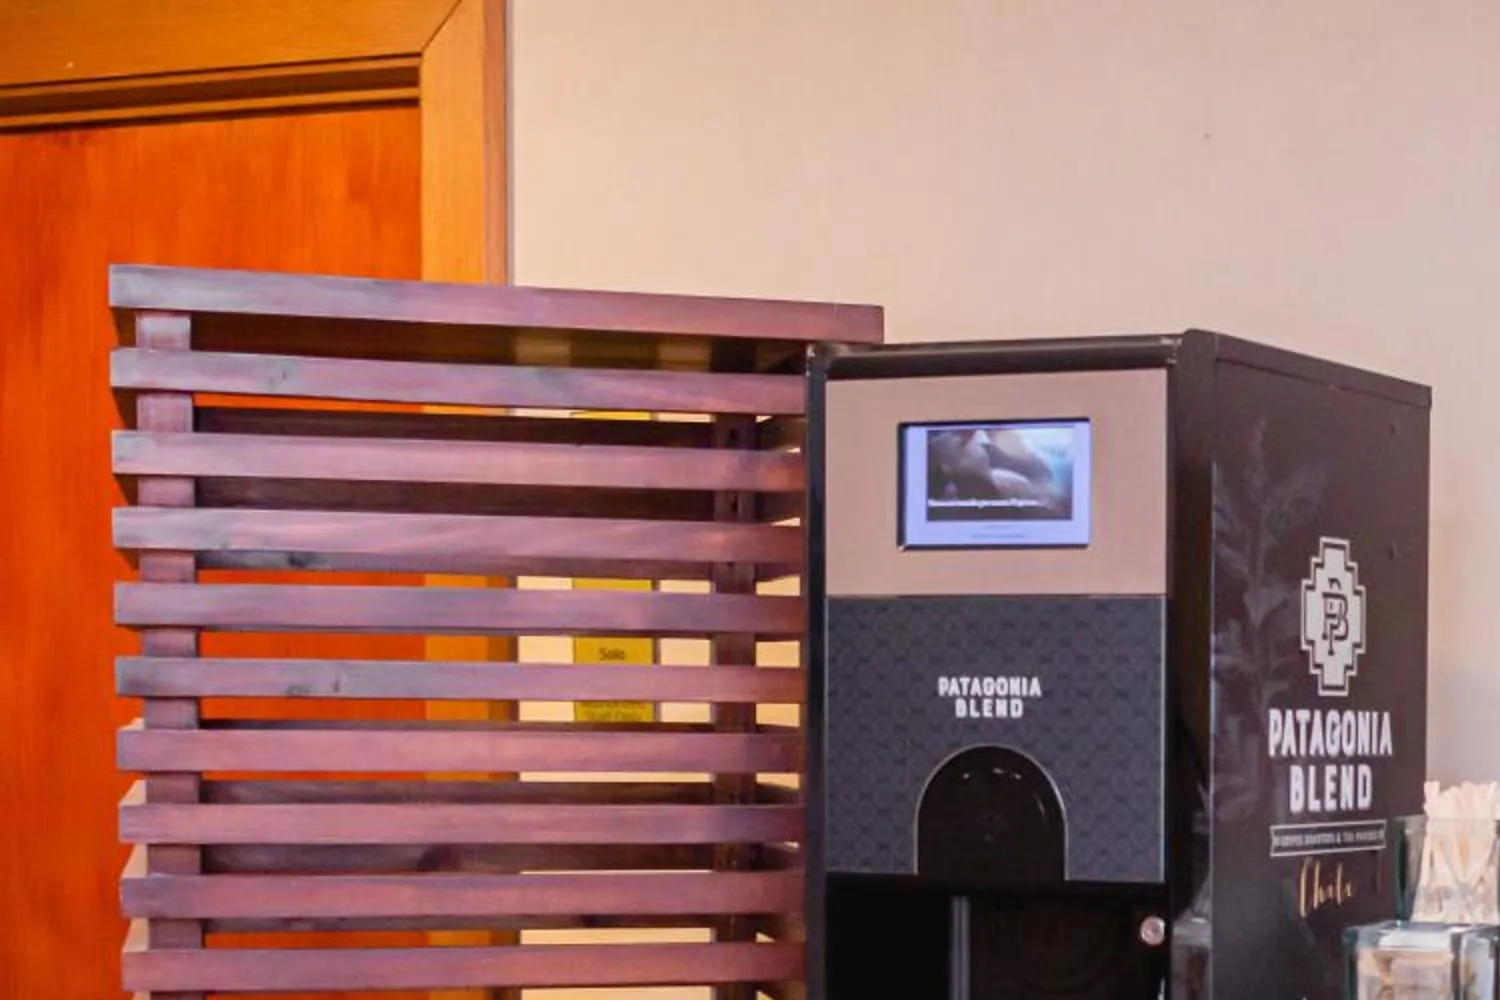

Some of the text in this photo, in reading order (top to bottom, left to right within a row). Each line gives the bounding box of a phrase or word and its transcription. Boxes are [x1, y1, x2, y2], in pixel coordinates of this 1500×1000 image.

[938, 676, 1042, 697] PATAGONIA
[955, 698, 1024, 718] BLEND
[1268, 707, 1393, 758] PATAGONIA
[1289, 763, 1373, 813] BLEND
